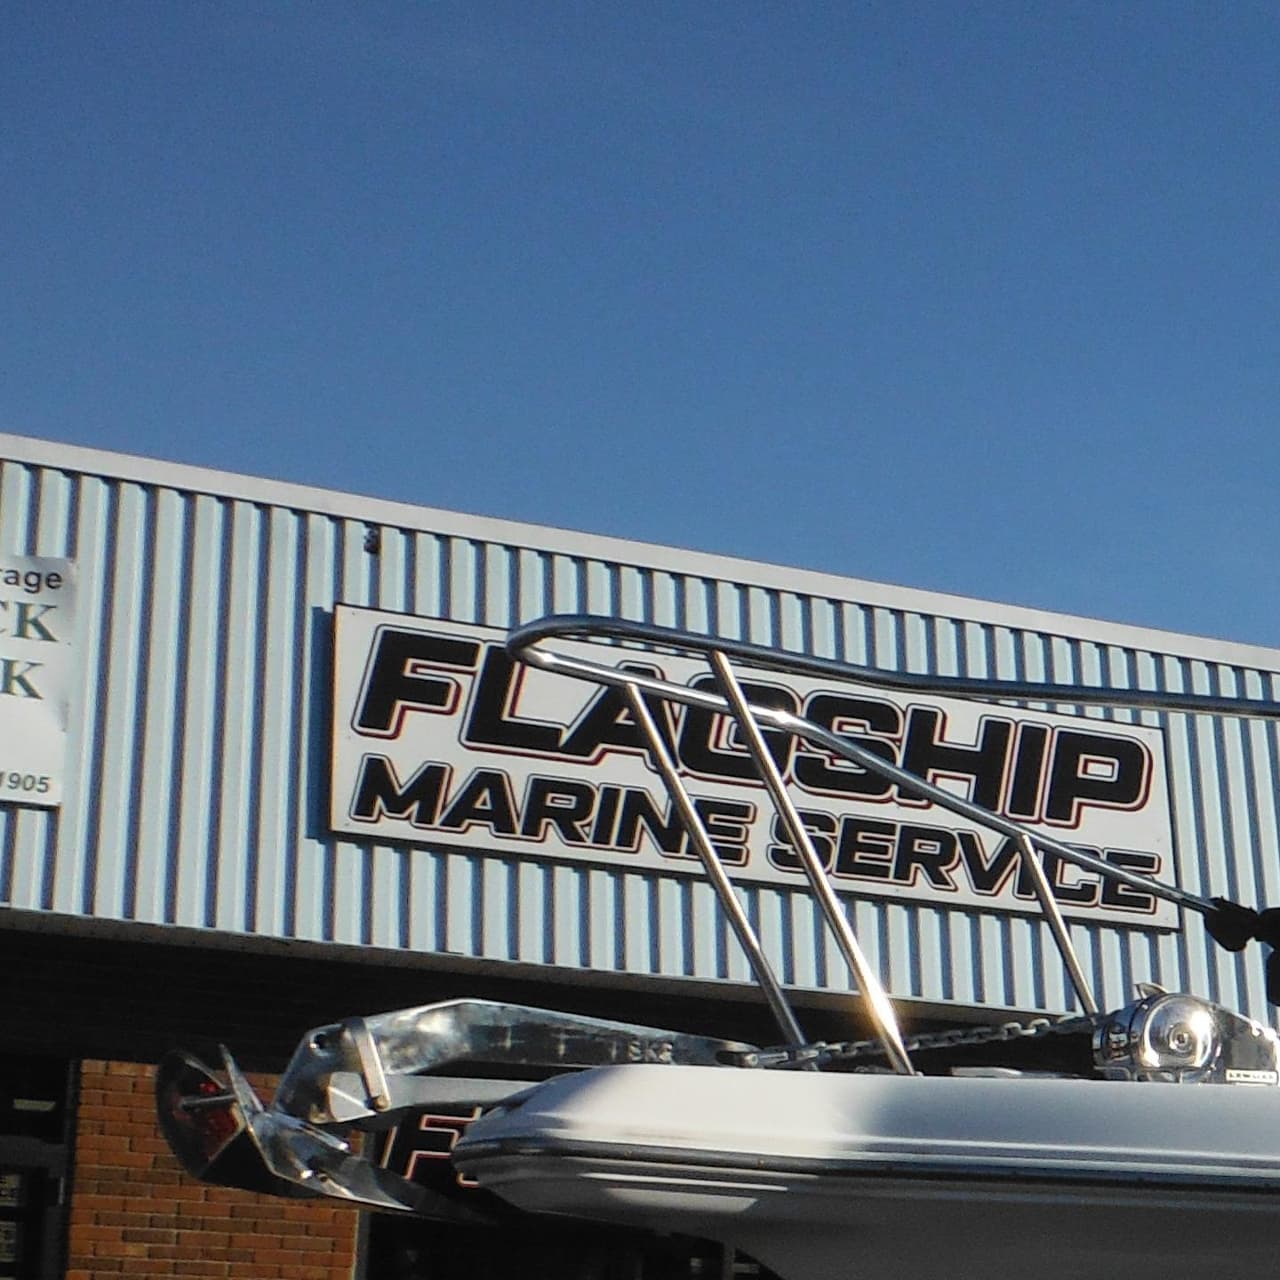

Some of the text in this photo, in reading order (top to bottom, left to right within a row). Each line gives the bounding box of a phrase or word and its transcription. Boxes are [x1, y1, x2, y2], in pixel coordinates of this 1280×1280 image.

[0, 569, 63, 594] age
[0, 601, 58, 642] K
[351, 624, 1153, 828] FLAGSHIP
[350, 753, 1161, 915] MARINE SERVICE
